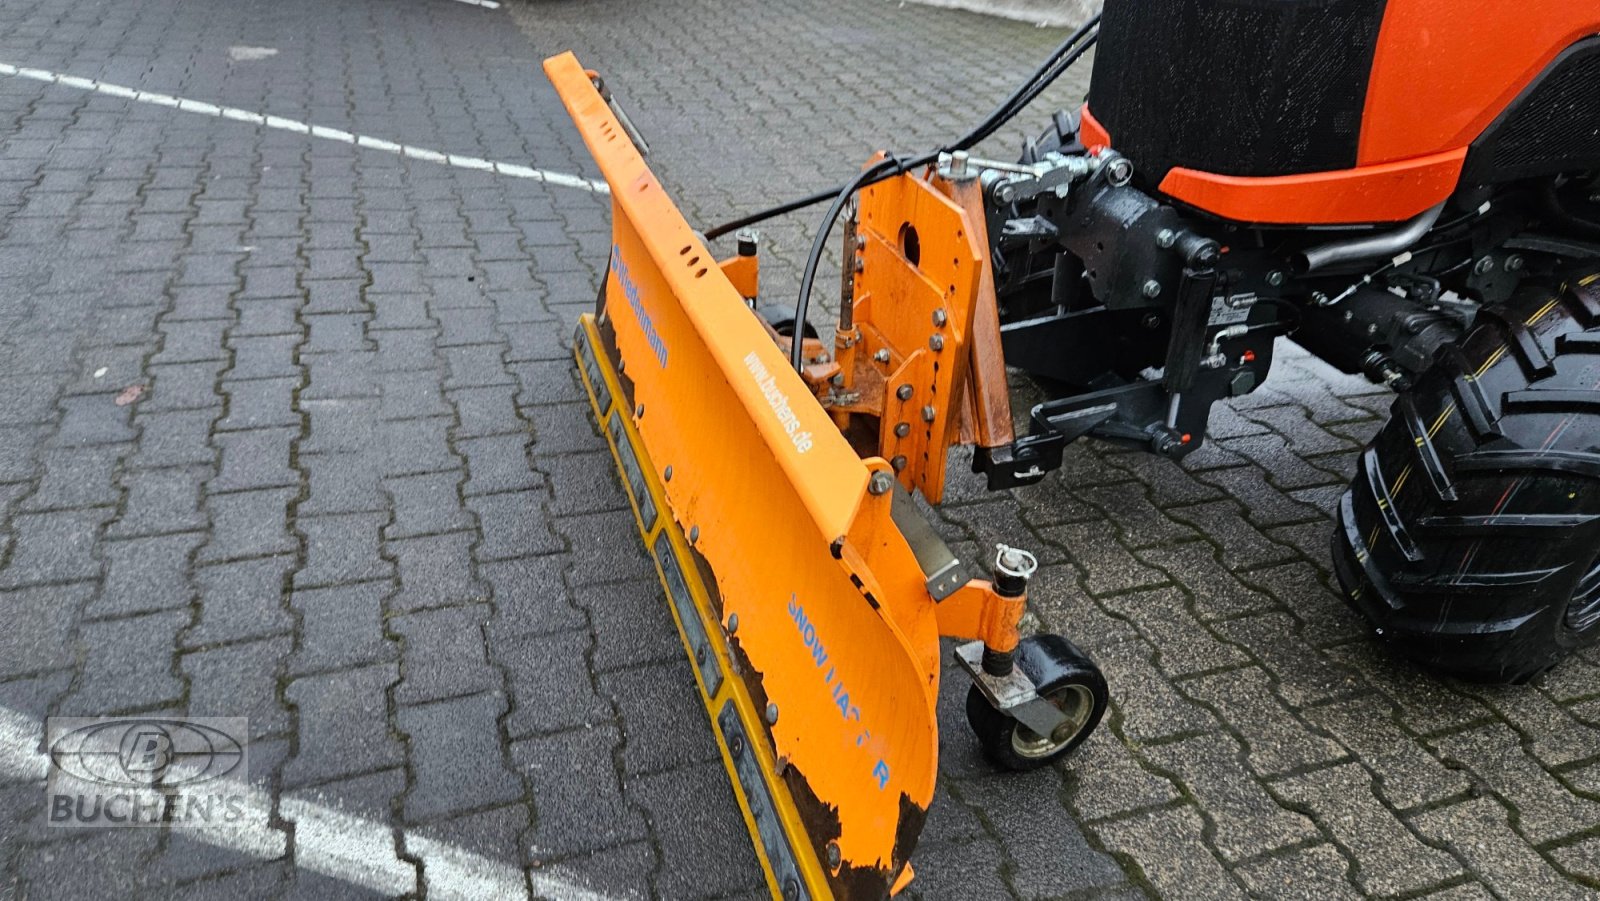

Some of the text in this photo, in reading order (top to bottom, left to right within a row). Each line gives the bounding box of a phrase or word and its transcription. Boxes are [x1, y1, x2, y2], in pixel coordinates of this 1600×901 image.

[617, 255, 668, 368] Wiedenmann
[744, 351, 812, 453] www.buchens.de
[788, 593, 827, 667] SNOW
